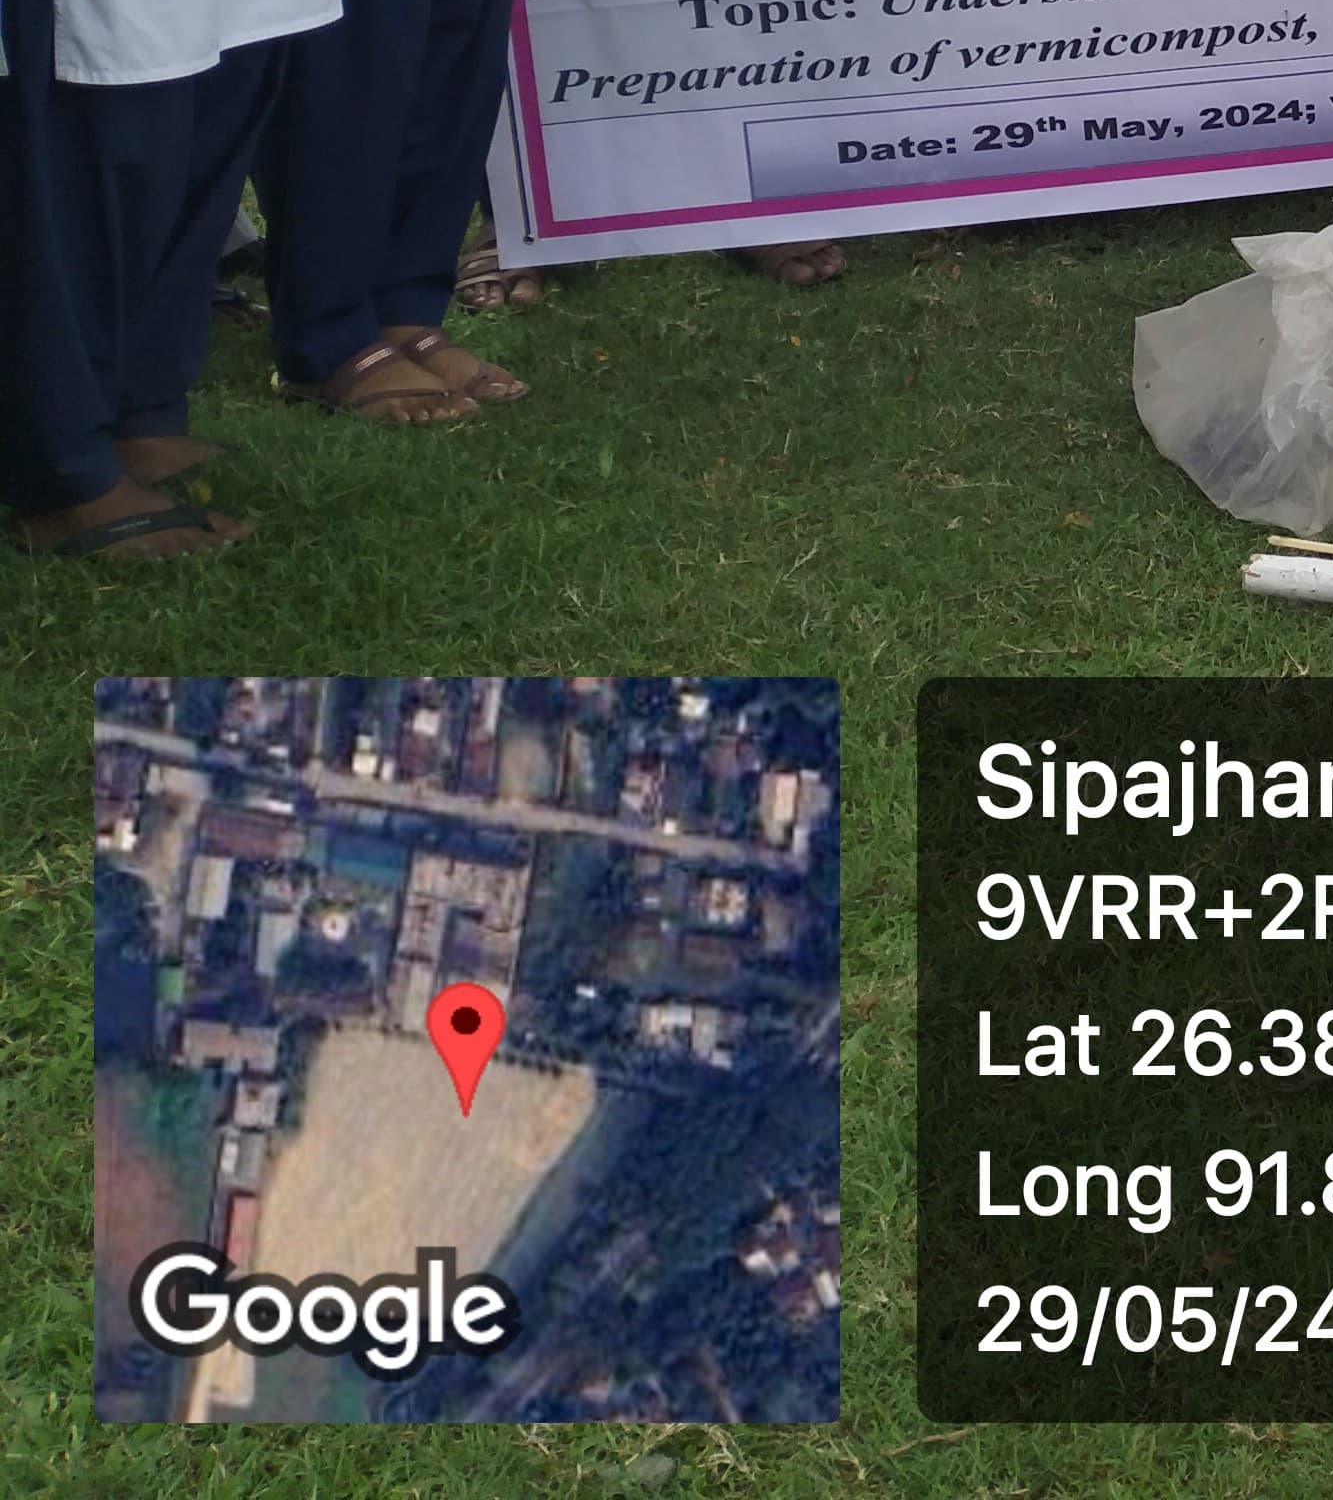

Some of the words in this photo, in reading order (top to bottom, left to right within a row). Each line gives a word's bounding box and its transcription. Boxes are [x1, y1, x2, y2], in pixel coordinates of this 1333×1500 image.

[549, 50, 870, 104] Preparation
[890, 39, 951, 82] of
[957, 10, 1317, 68] vermicompost,
[838, 136, 956, 164] Date:
[973, 116, 1066, 151] 29th
[1083, 117, 1183, 141] May,
[1199, 100, 1315, 130] 2024;
